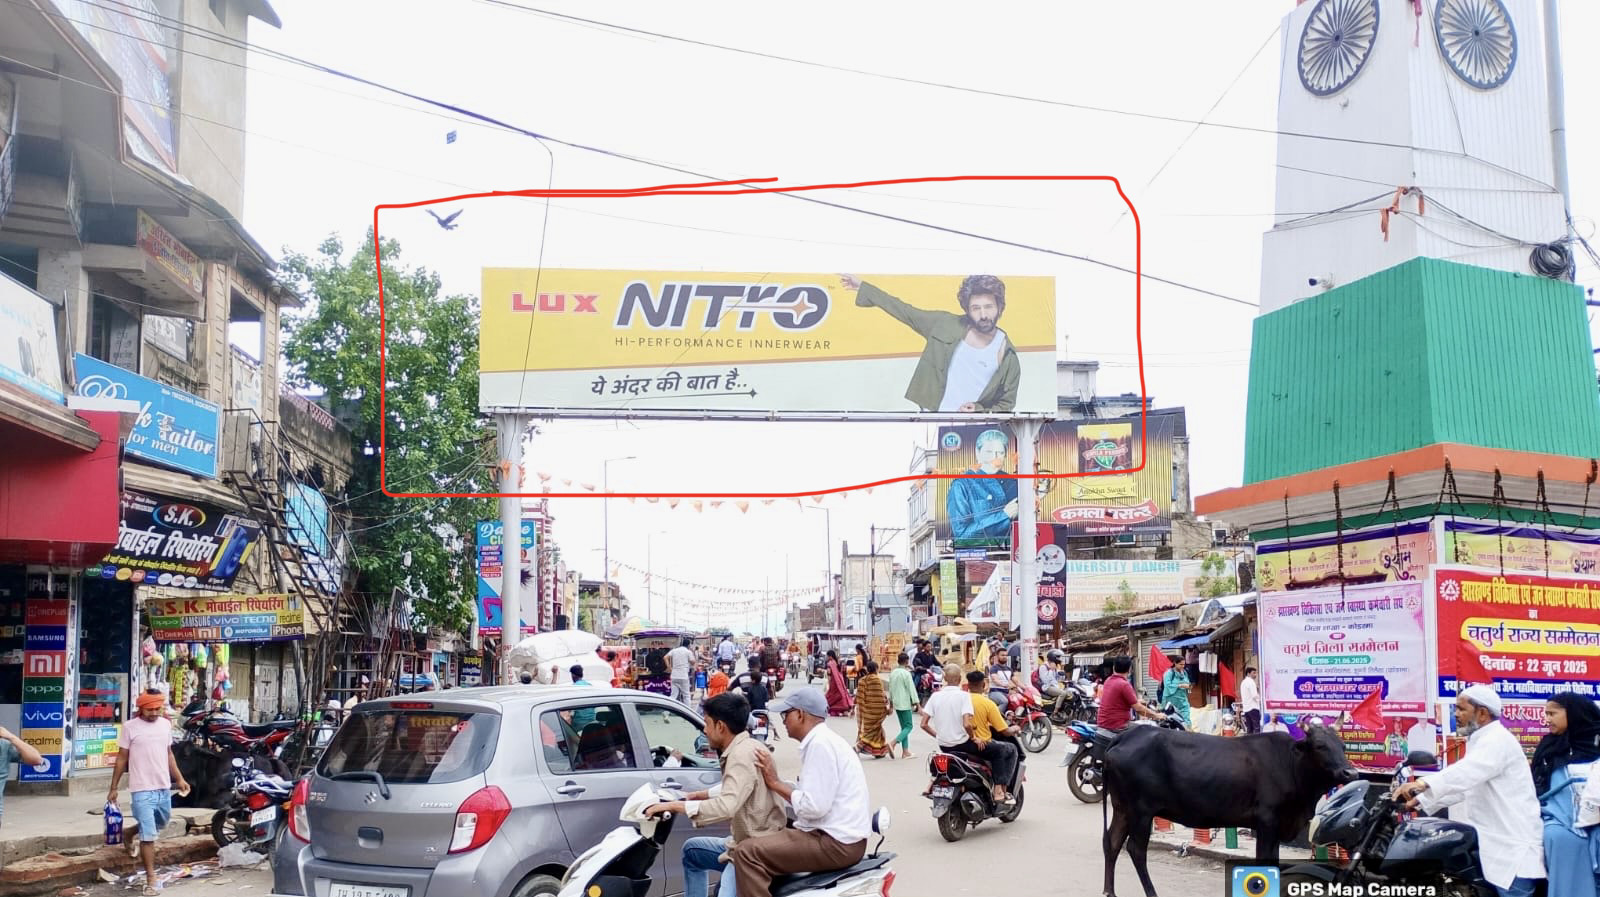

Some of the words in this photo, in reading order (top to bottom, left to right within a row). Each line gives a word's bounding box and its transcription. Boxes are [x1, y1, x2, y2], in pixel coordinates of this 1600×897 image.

[511, 292, 599, 313] LUX
[615, 337, 743, 349] HI-PERFORMANCE
[749, 339, 832, 350] INNERWEAR
[591, 375, 606, 396] ये
[611, 373, 651, 395] अंदर
[656, 371, 682, 392] की
[686, 374, 721, 391] बात
[151, 439, 179, 456] men
[163, 505, 194, 526] S.K.
[1060, 507, 1105, 520] कमला
[165, 600, 204, 615] S.K.
[180, 615, 211, 628] SAMSUNG
[213, 616, 240, 625] vivo
[244, 615, 277, 624] TECNO
[272, 625, 302, 636] iPhone
[1467, 622, 1504, 647] चतुर्थ
[1507, 627, 1541, 643] राज्य
[1544, 626, 1600, 646] सम्मेलन
[1314, 640, 1344, 654] जिला
[1348, 638, 1401, 652] सम्मेलन
[1479, 655, 1516, 671] दिनांक
[1526, 659, 1539, 671] 22
[1541, 660, 1562, 677] जून
[1563, 660, 1588, 673] 2025
[25, 685, 63, 694] oppo
[24, 710, 63, 720] vivo
[23, 736, 62, 746] realme
